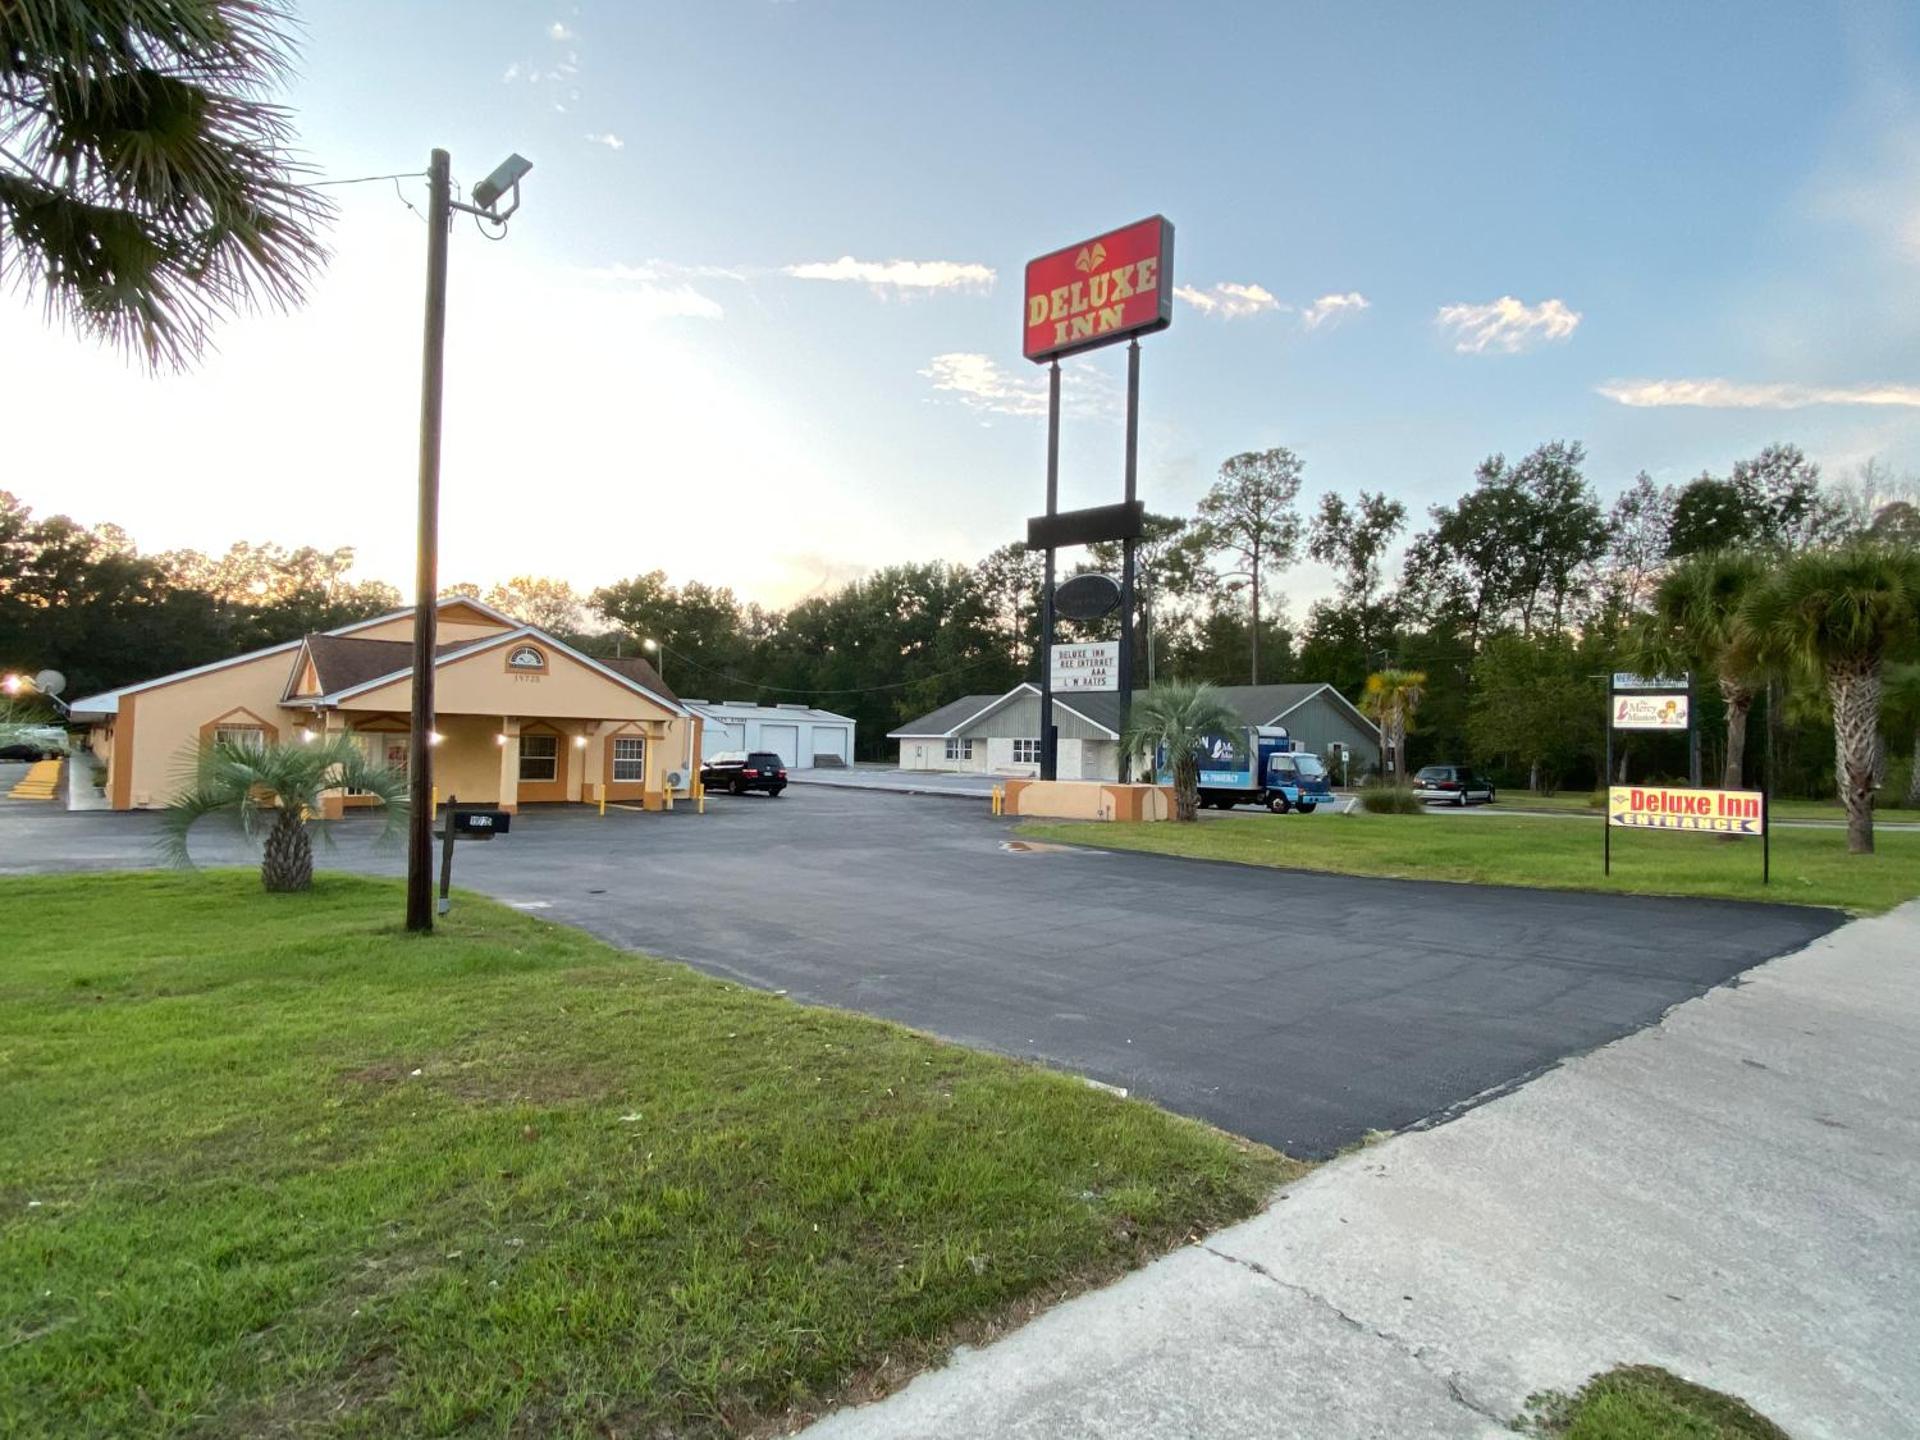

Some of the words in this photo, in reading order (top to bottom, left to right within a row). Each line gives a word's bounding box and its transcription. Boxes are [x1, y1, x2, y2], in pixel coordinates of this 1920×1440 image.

[1028, 256, 1157, 328] DELUXE
[1054, 303, 1125, 345] INN
[1059, 649, 1087, 659] DELUXE
[1093, 649, 1105, 657] INN
[1078, 658, 1112, 667] INTERNET
[1092, 668, 1106, 676] AAA
[1084, 677, 1106, 686] RATES
[1630, 703, 1657, 714] Mercy
[1628, 712, 1657, 721] Mission
[1630, 789, 1711, 815] Deluxe
[1718, 793, 1759, 818] Inn
[1623, 813, 1742, 831] ENTRANCE
